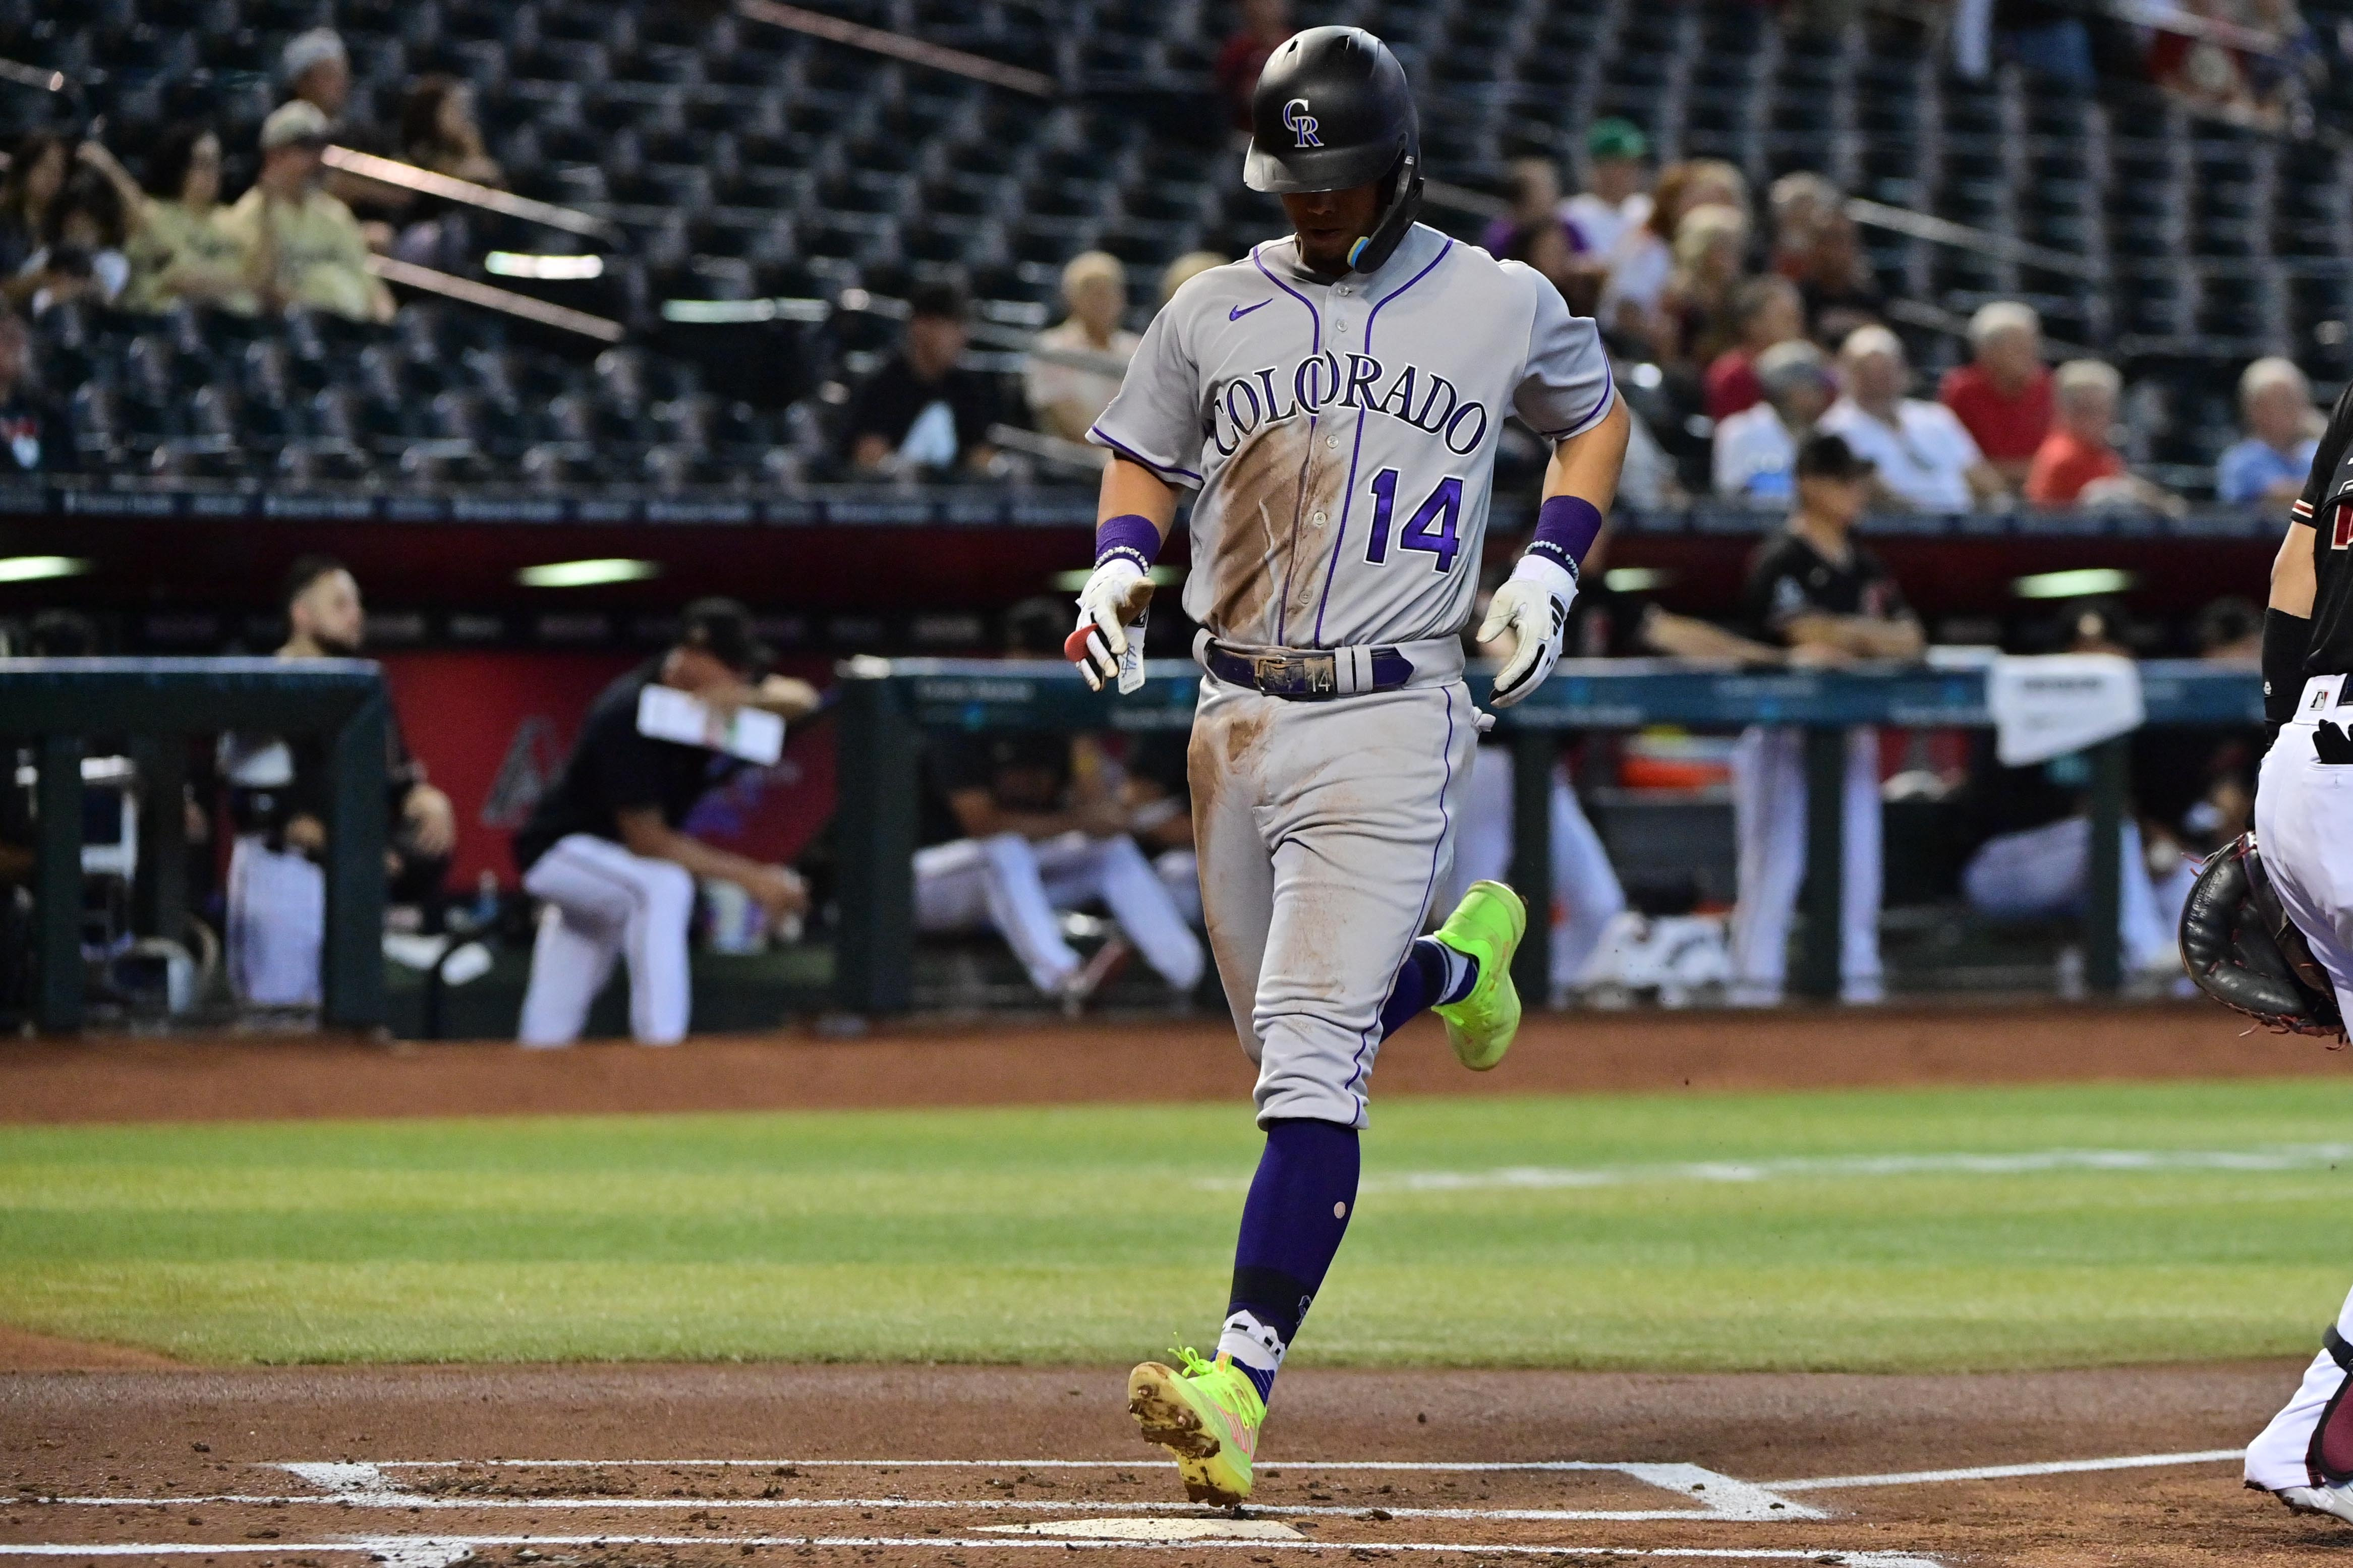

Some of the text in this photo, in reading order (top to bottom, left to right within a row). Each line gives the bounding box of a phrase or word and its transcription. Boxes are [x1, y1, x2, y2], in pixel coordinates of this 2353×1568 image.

[1213, 348, 1488, 456] COLORADO
[1363, 466, 1464, 575] 14
[1307, 667, 1331, 692] 14
